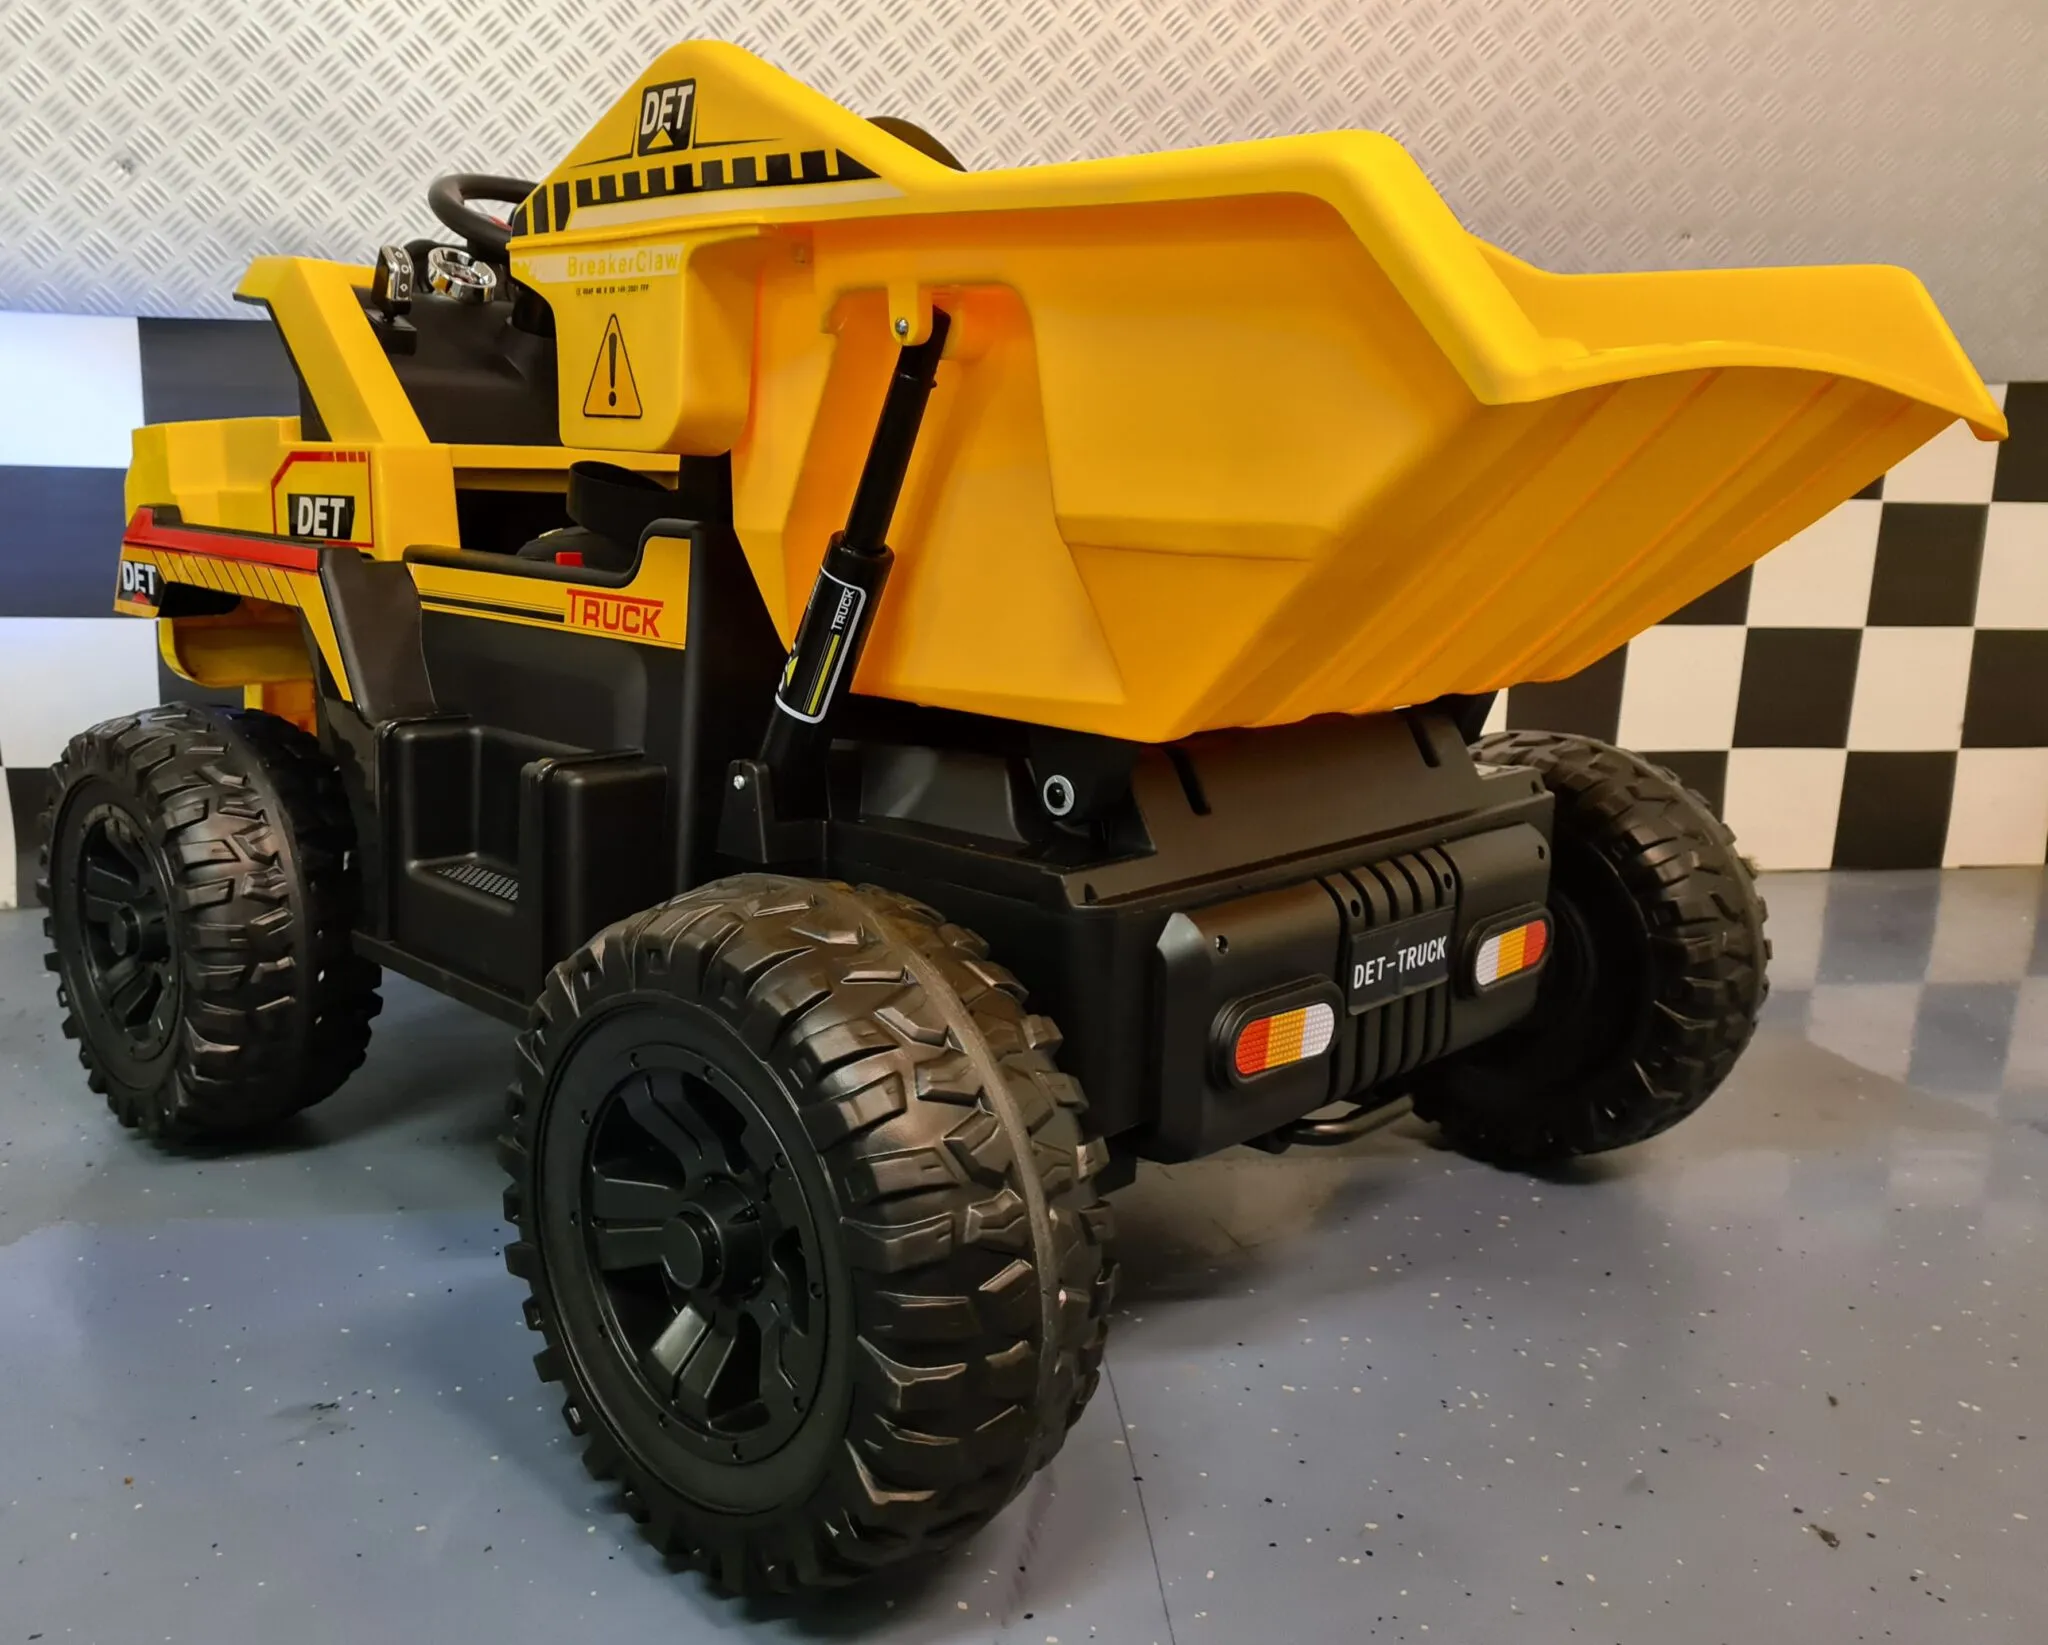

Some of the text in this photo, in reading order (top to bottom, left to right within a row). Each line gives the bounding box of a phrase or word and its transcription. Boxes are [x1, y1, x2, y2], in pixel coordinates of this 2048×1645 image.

[641, 84, 694, 135] DET
[567, 250, 679, 277] BreakerClaw
[297, 496, 345, 537] DET
[122, 560, 156, 595] DET
[566, 588, 664, 638] TRUCK
[830, 586, 855, 631] TRUCK
[1353, 935, 1447, 989] DET-TRUCK
